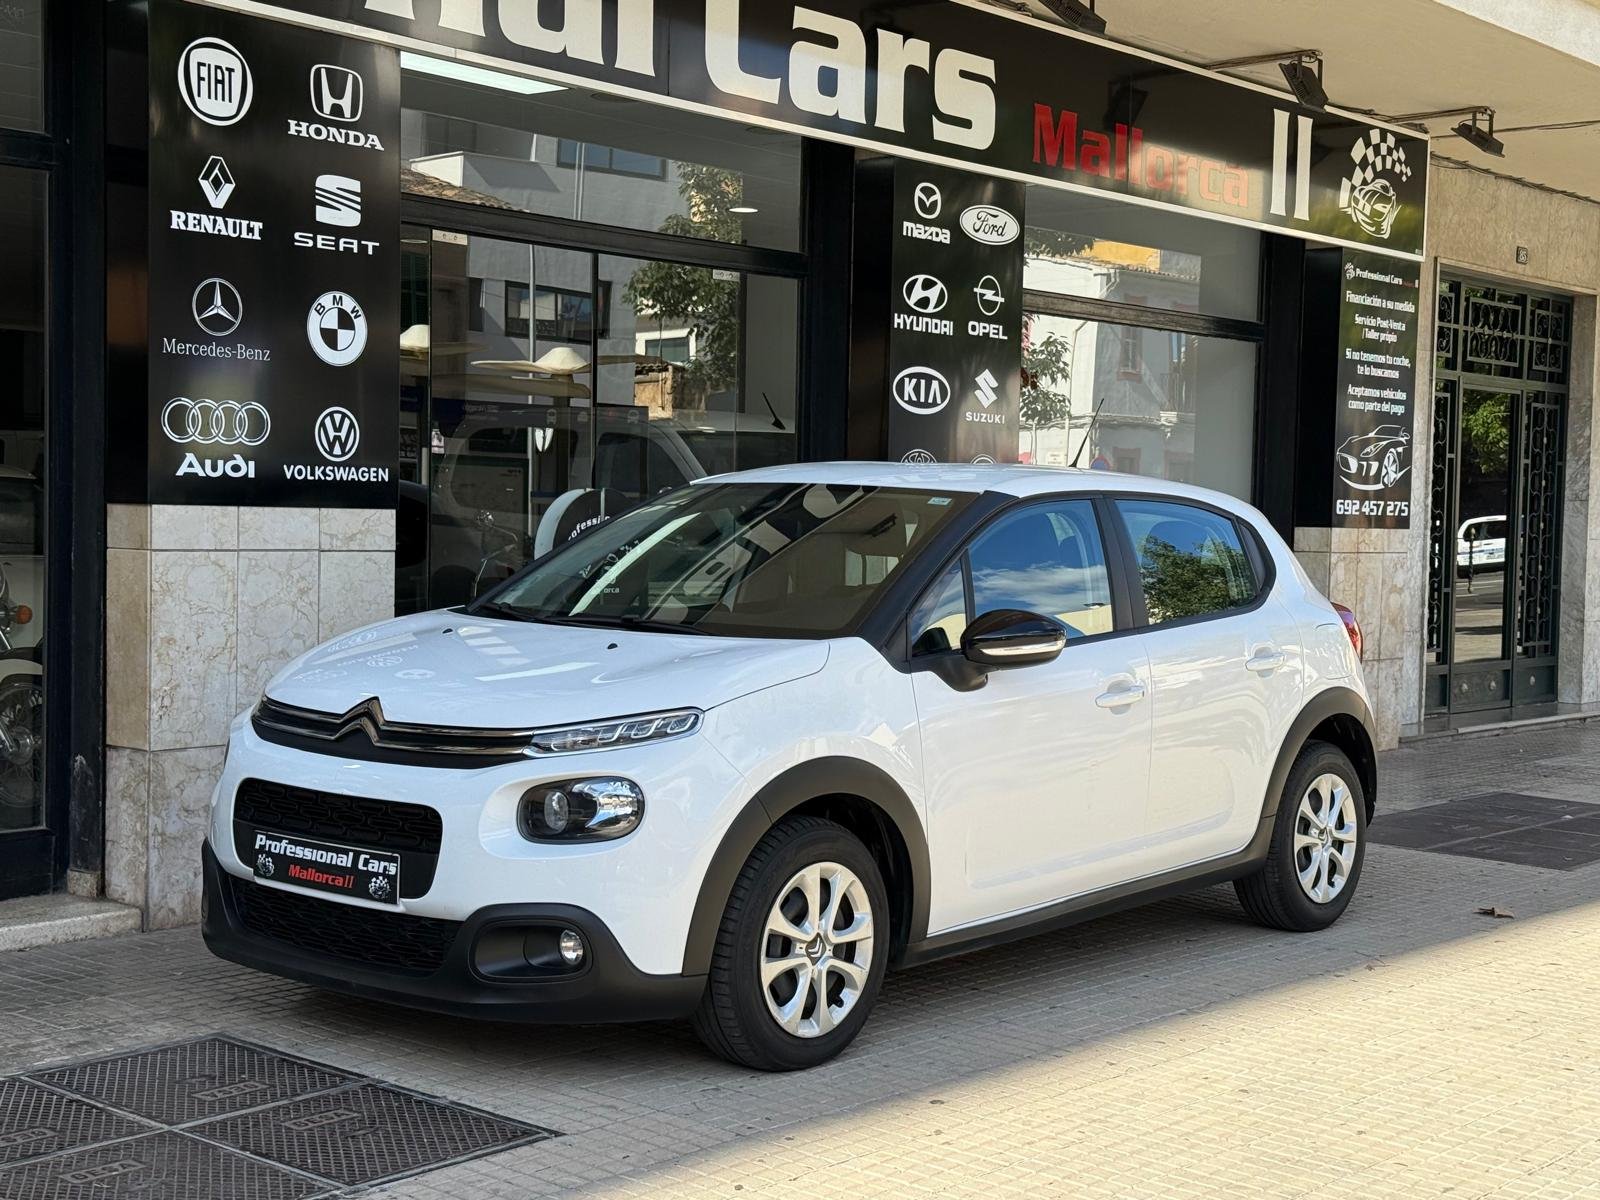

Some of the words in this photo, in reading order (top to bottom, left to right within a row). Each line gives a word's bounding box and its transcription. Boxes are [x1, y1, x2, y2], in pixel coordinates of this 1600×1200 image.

[197, 61, 235, 103] FIAT
[287, 119, 385, 151] HONDA
[1032, 102, 1249, 208] Mallorca
[170, 210, 263, 241] RENAULT
[972, 210, 1008, 238] Ford
[293, 231, 380, 255] SEAT
[1355, 268, 1391, 283] Professional
[1391, 275, 1403, 285] Cars
[313, 294, 362, 321] BMW
[1345, 290, 1382, 308] Financiación
[1382, 299, 1387, 308] a
[1387, 300, 1394, 309] su
[1394, 301, 1416, 313] medida
[893, 313, 953, 336] HYUNDAI
[967, 321, 1008, 340] OPEL
[1354, 314, 1377, 327] Servicio
[1376, 317, 1406, 331] Post-Venta
[1365, 328, 1380, 340] Taller
[162, 338, 271, 361] Mercedes-Benz
[1345, 348, 1352, 359] Si
[1352, 351, 1360, 360] no
[1360, 351, 1386, 364] tenemos
[1386, 354, 1393, 364] tu
[1393, 356, 1411, 368] coche,
[1357, 364, 1364, 375] te
[1364, 364, 1371, 375] lo
[1370, 365, 1400, 379] buscamos
[903, 377, 942, 404] KIA
[1347, 384, 1380, 398] Aceptamos
[965, 411, 1005, 425] SUZUKI
[1348, 400, 1364, 410] como
[1364, 401, 1381, 412] parte
[1381, 401, 1391, 412] del
[1390, 404, 1405, 416] pago
[175, 452, 255, 478] Audi
[283, 464, 389, 482] VOLKSWAGEN
[1336, 499, 1360, 515] 692
[1361, 500, 1385, 516] 457
[1386, 501, 1409, 517] 275
[254, 834, 354, 867] Professional
[358, 854, 398, 876] Cars
[288, 864, 343, 888] Mallorca
